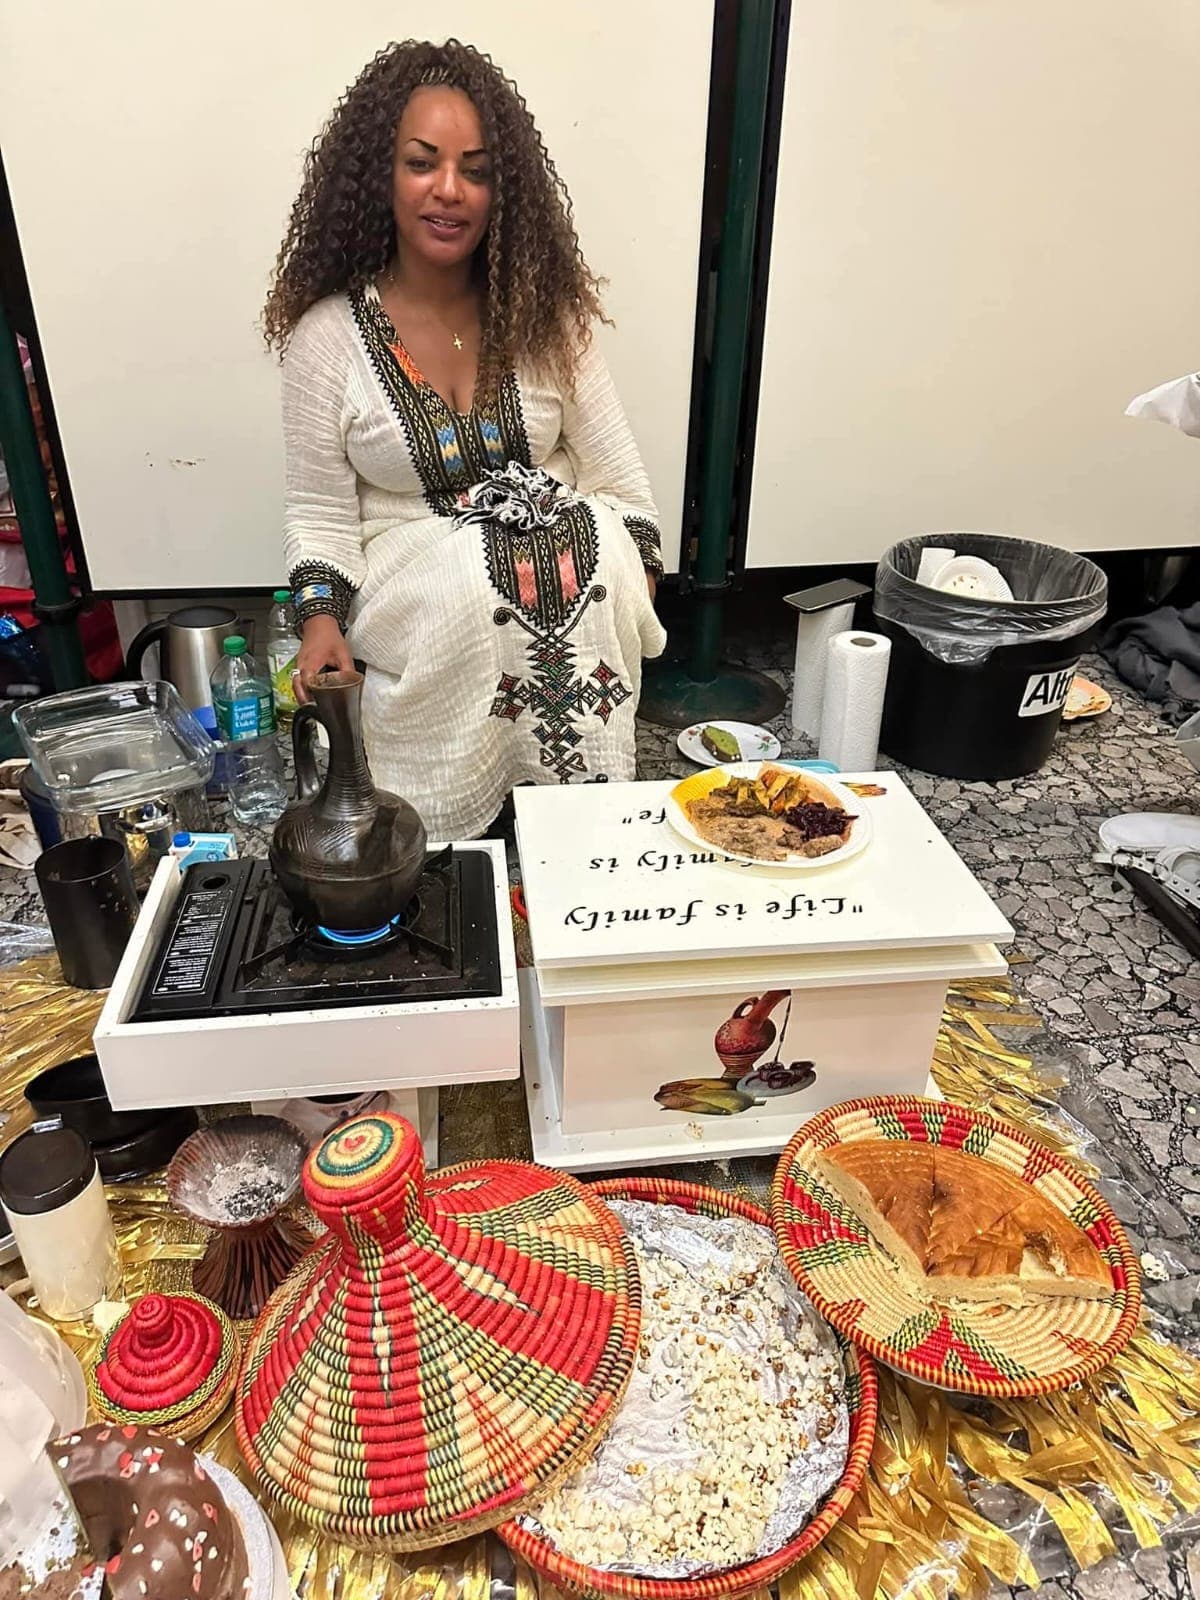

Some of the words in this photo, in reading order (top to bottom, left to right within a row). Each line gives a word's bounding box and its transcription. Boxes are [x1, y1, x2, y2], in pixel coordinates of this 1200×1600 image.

[589, 856, 619, 873] is
[637, 850, 753, 872] mily
[564, 899, 704, 932] family
[715, 903, 747, 921] is
